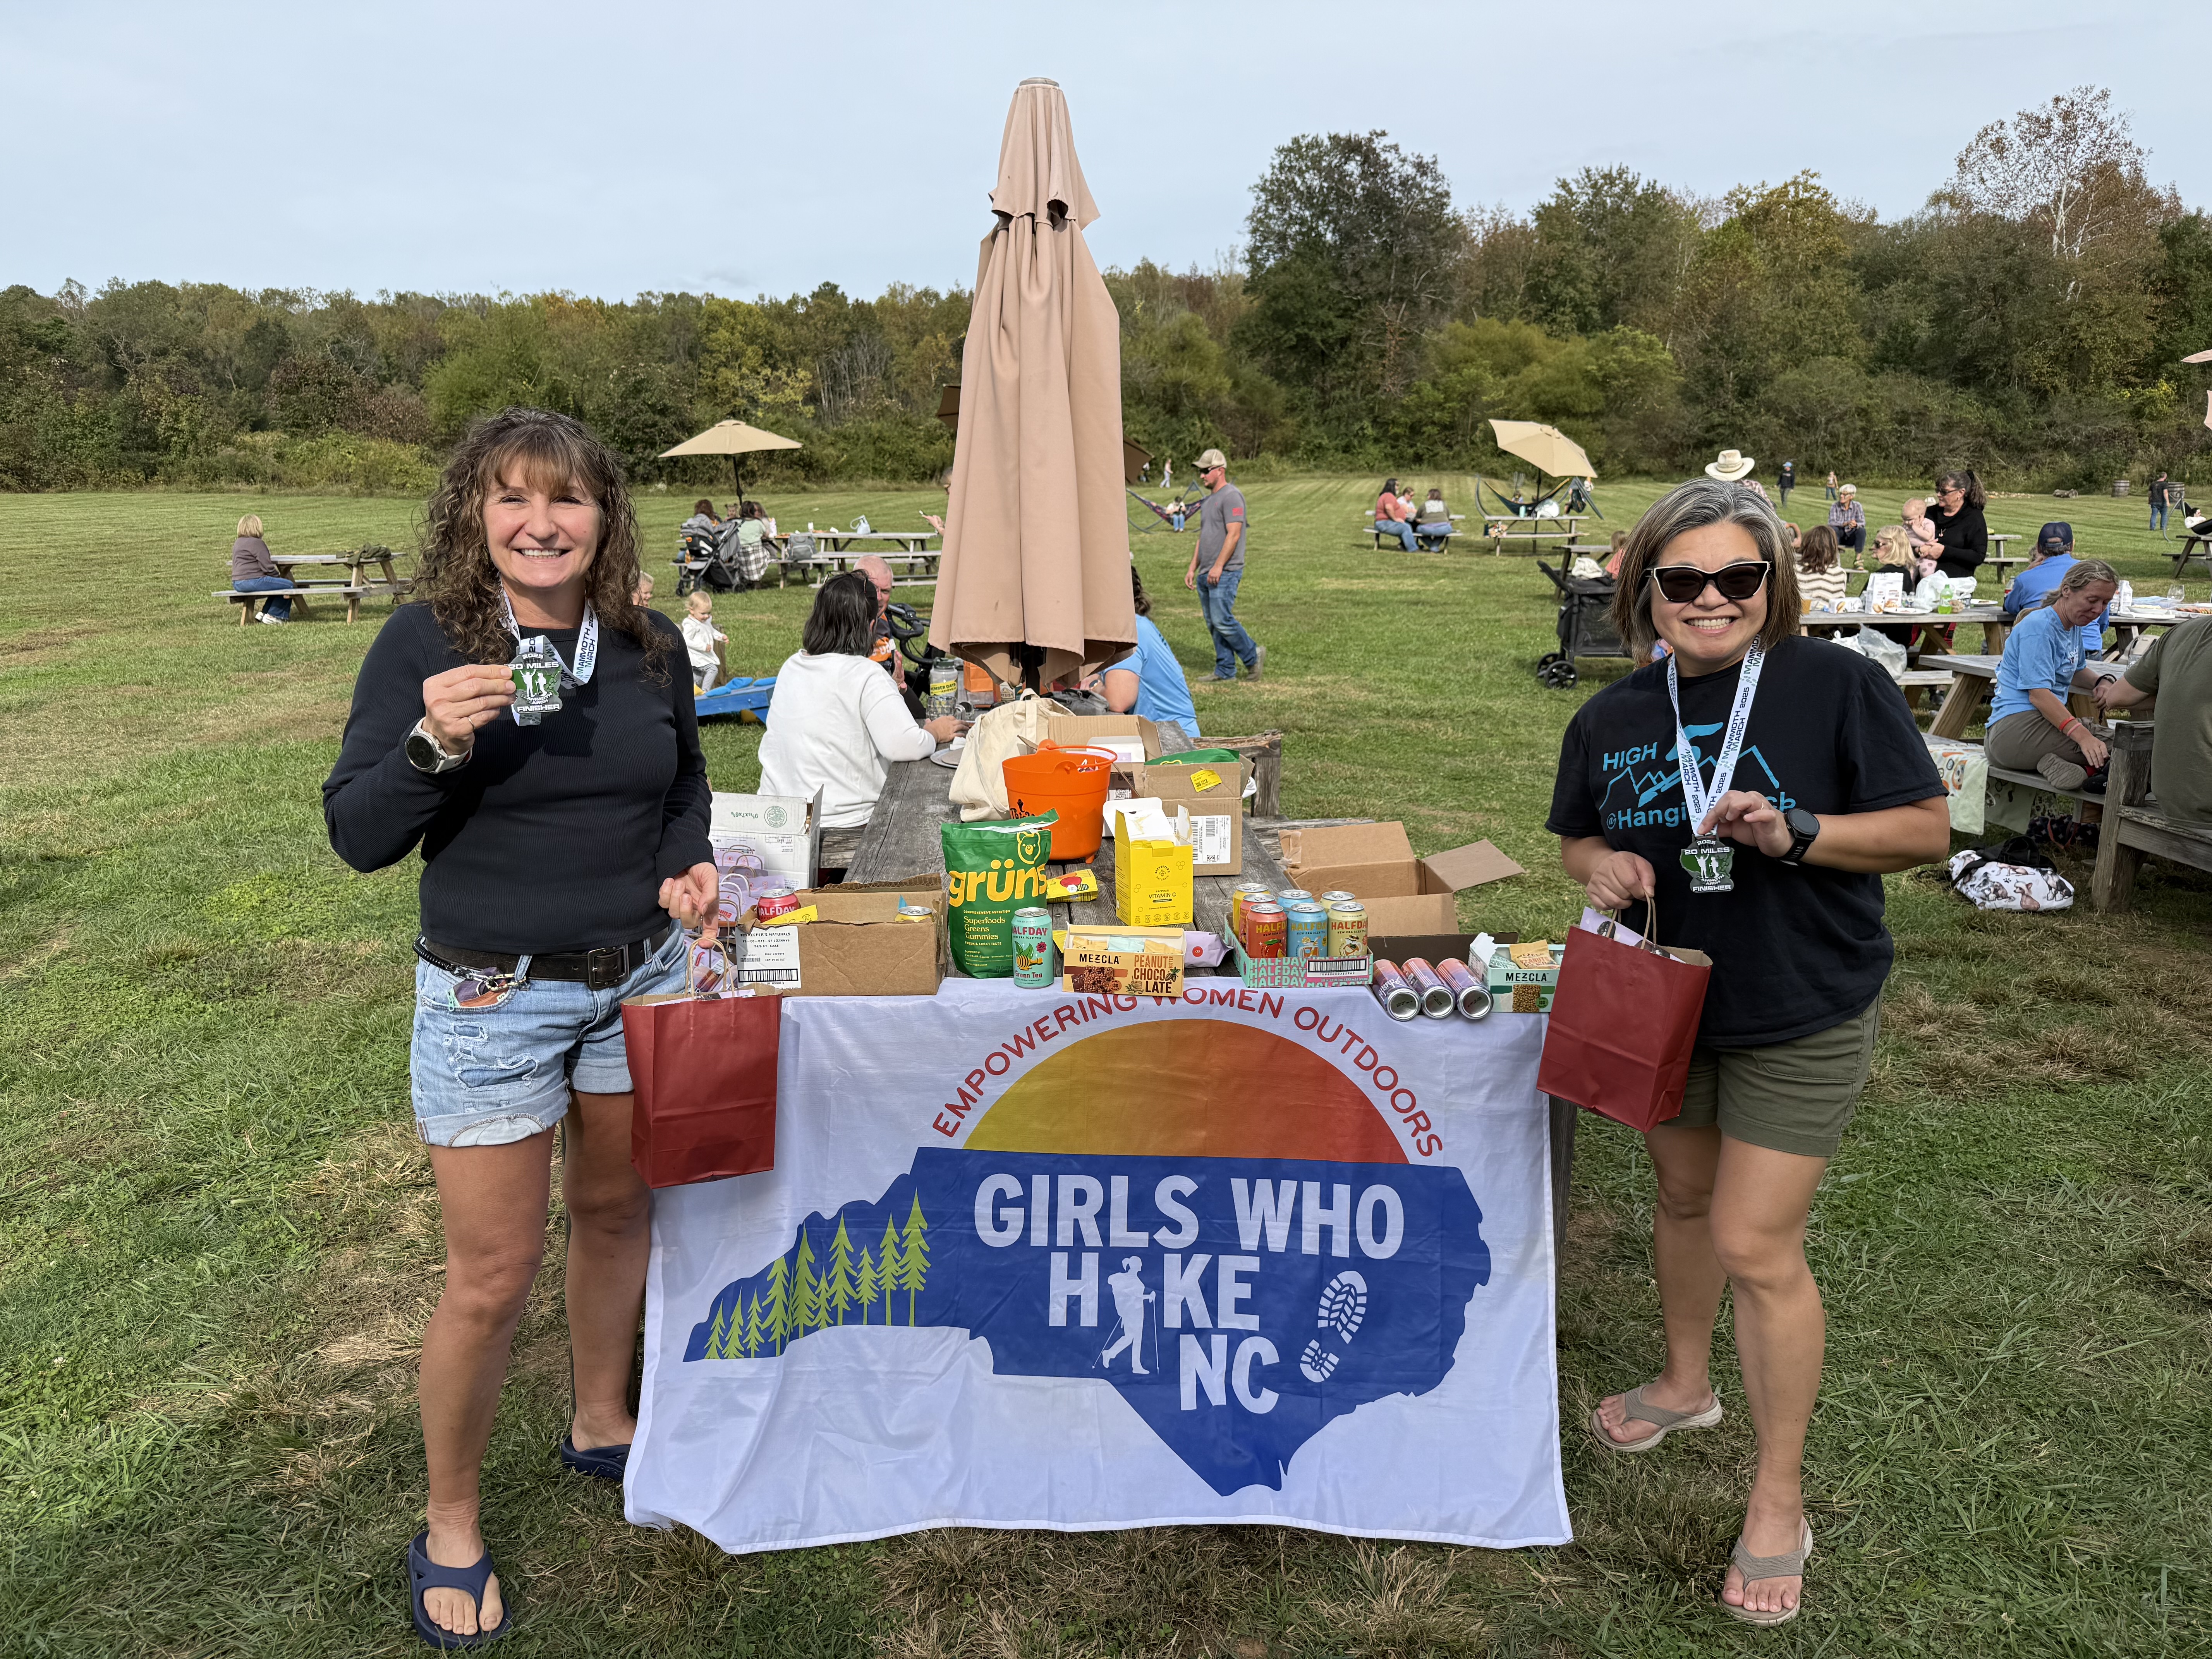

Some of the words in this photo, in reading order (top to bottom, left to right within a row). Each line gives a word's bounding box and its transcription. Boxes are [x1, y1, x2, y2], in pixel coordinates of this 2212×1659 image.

[576, 628, 590, 674] MAMMOTH
[585, 639, 595, 667] MARCH
[1740, 687, 1749, 708] 2025
[517, 704, 560, 712] FINISHER
[1723, 711, 1741, 759] MAMMOTH
[1731, 718, 1746, 751] MARCH
[1602, 742, 1658, 771] HIGH
[1680, 754, 1692, 785] MARCH
[1685, 749, 1700, 792] MAMMOTH
[1716, 772, 1727, 793] 2025
[1692, 794, 1702, 814] 2025
[949, 859, 1047, 907] grüns
[964, 916, 1006, 925] Superfoods
[1256, 921, 1287, 934] HALFD
[1331, 921, 1368, 930] HALFDA
[1012, 926, 1048, 936] ALFDAY
[1079, 953, 1120, 965] MEZCLA
[1134, 955, 1168, 968] PEANUT
[1250, 957, 1307, 967] HALFDAY
[1015, 970, 1030, 978] Green
[1133, 968, 1166, 981] CHOCO
[1250, 966, 1307, 980] HALFDAY
[1250, 975, 1307, 988] HALFDAY
[1506, 972, 1547, 982] MEZCLA
[1145, 981, 1172, 994] LATE
[932, 994, 1137, 1137] EMPOWERING
[1294, 1006, 1443, 1157] OUTDOORS
[974, 1173, 1199, 1249] GIRLS
[1231, 1178, 1404, 1259] WHO
[1049, 1251, 1260, 1331] HKE
[1180, 1334, 1280, 1414] NC
